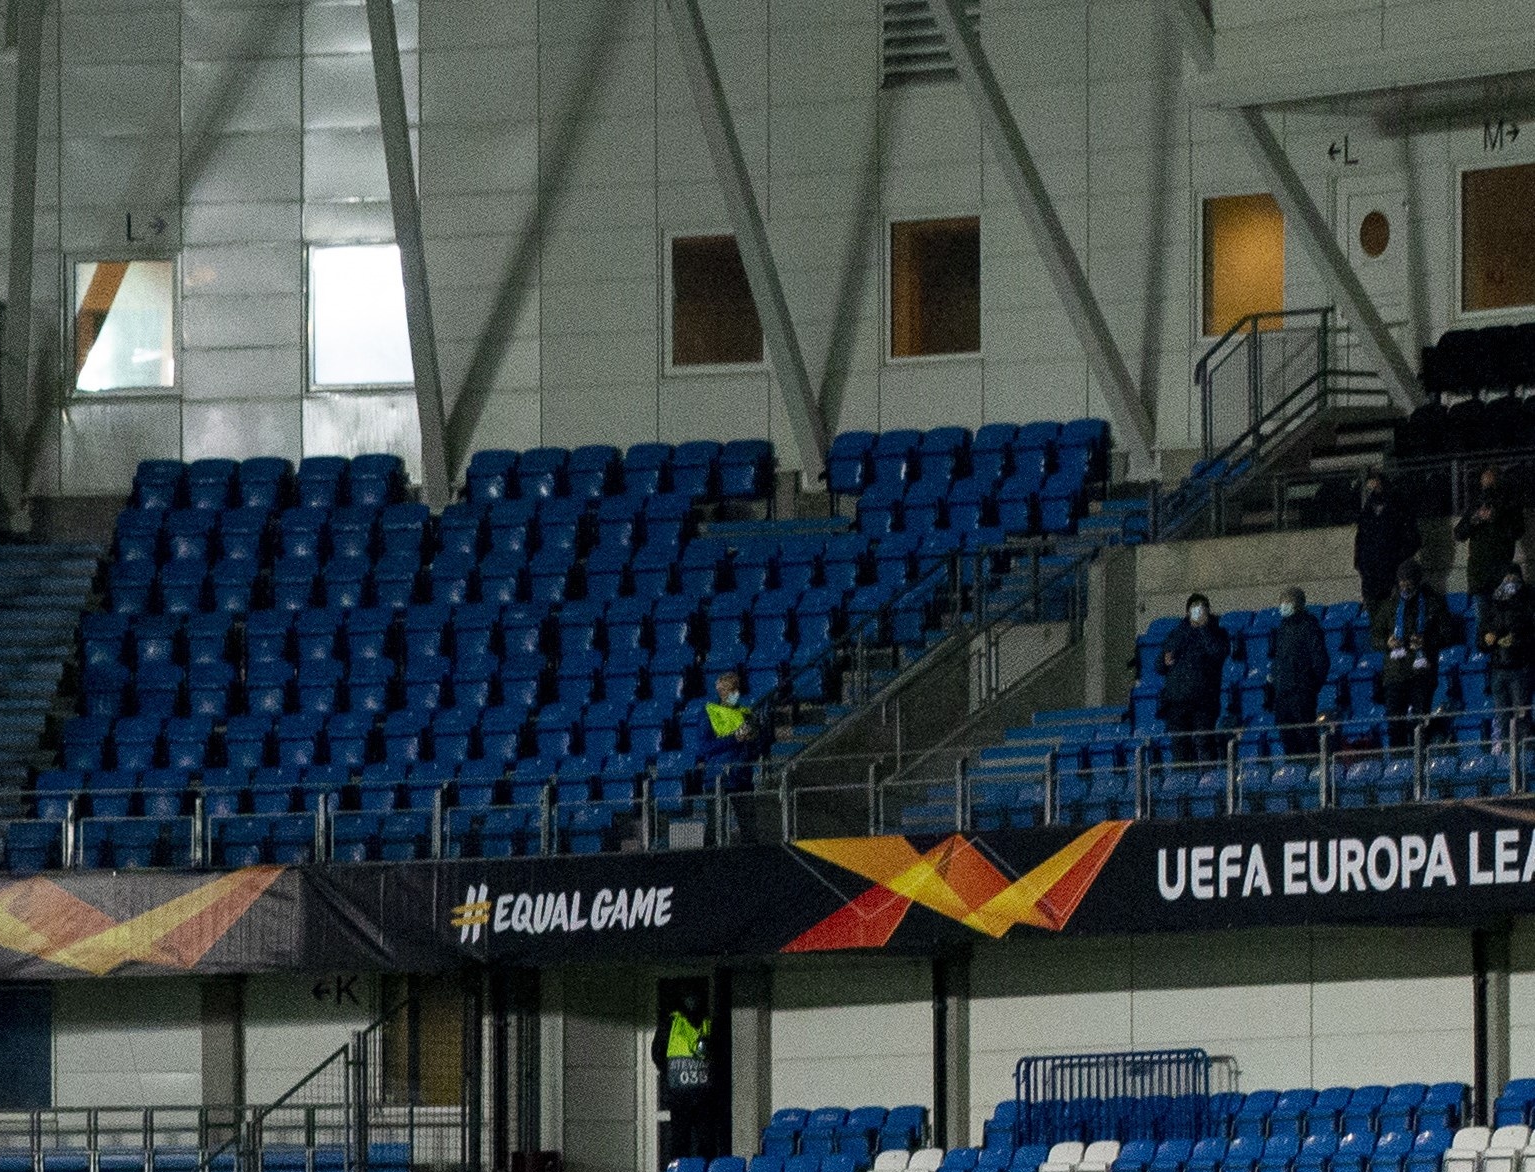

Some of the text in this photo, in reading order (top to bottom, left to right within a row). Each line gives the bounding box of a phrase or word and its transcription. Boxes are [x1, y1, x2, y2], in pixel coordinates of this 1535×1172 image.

[1343, 135, 1358, 165] L
[1157, 842, 1272, 901] UEFA
[1283, 835, 1457, 896] EUROPA
[335, 976, 359, 1004] K
